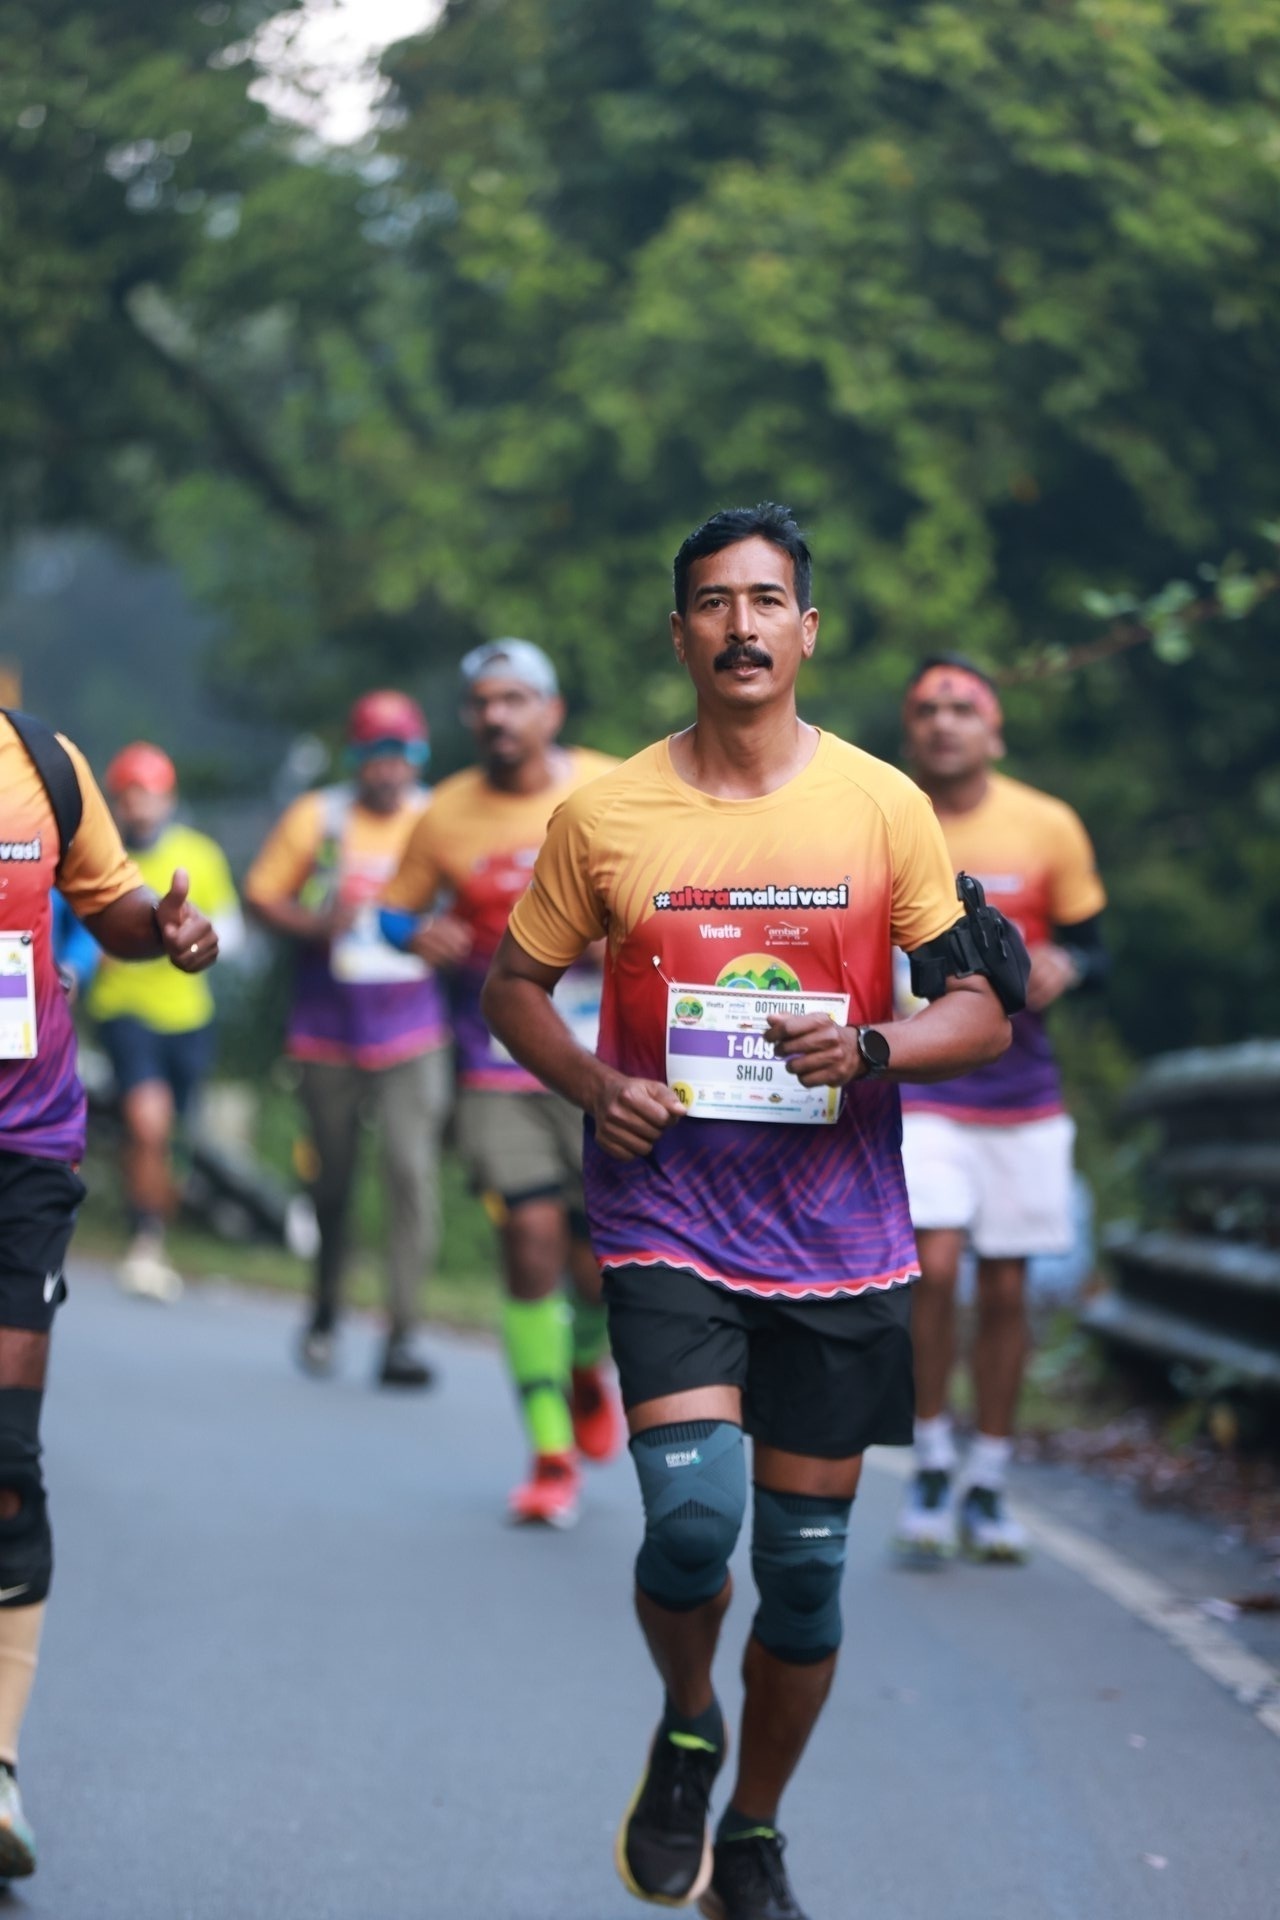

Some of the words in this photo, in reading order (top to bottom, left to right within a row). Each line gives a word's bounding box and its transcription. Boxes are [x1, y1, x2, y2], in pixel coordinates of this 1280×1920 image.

[654, 884, 849, 911] #ultramalaivasi
[699, 924, 742, 939] Vivatta
[727, 1034, 783, 1062] T-049
[736, 1064, 773, 1082] SHIJO
